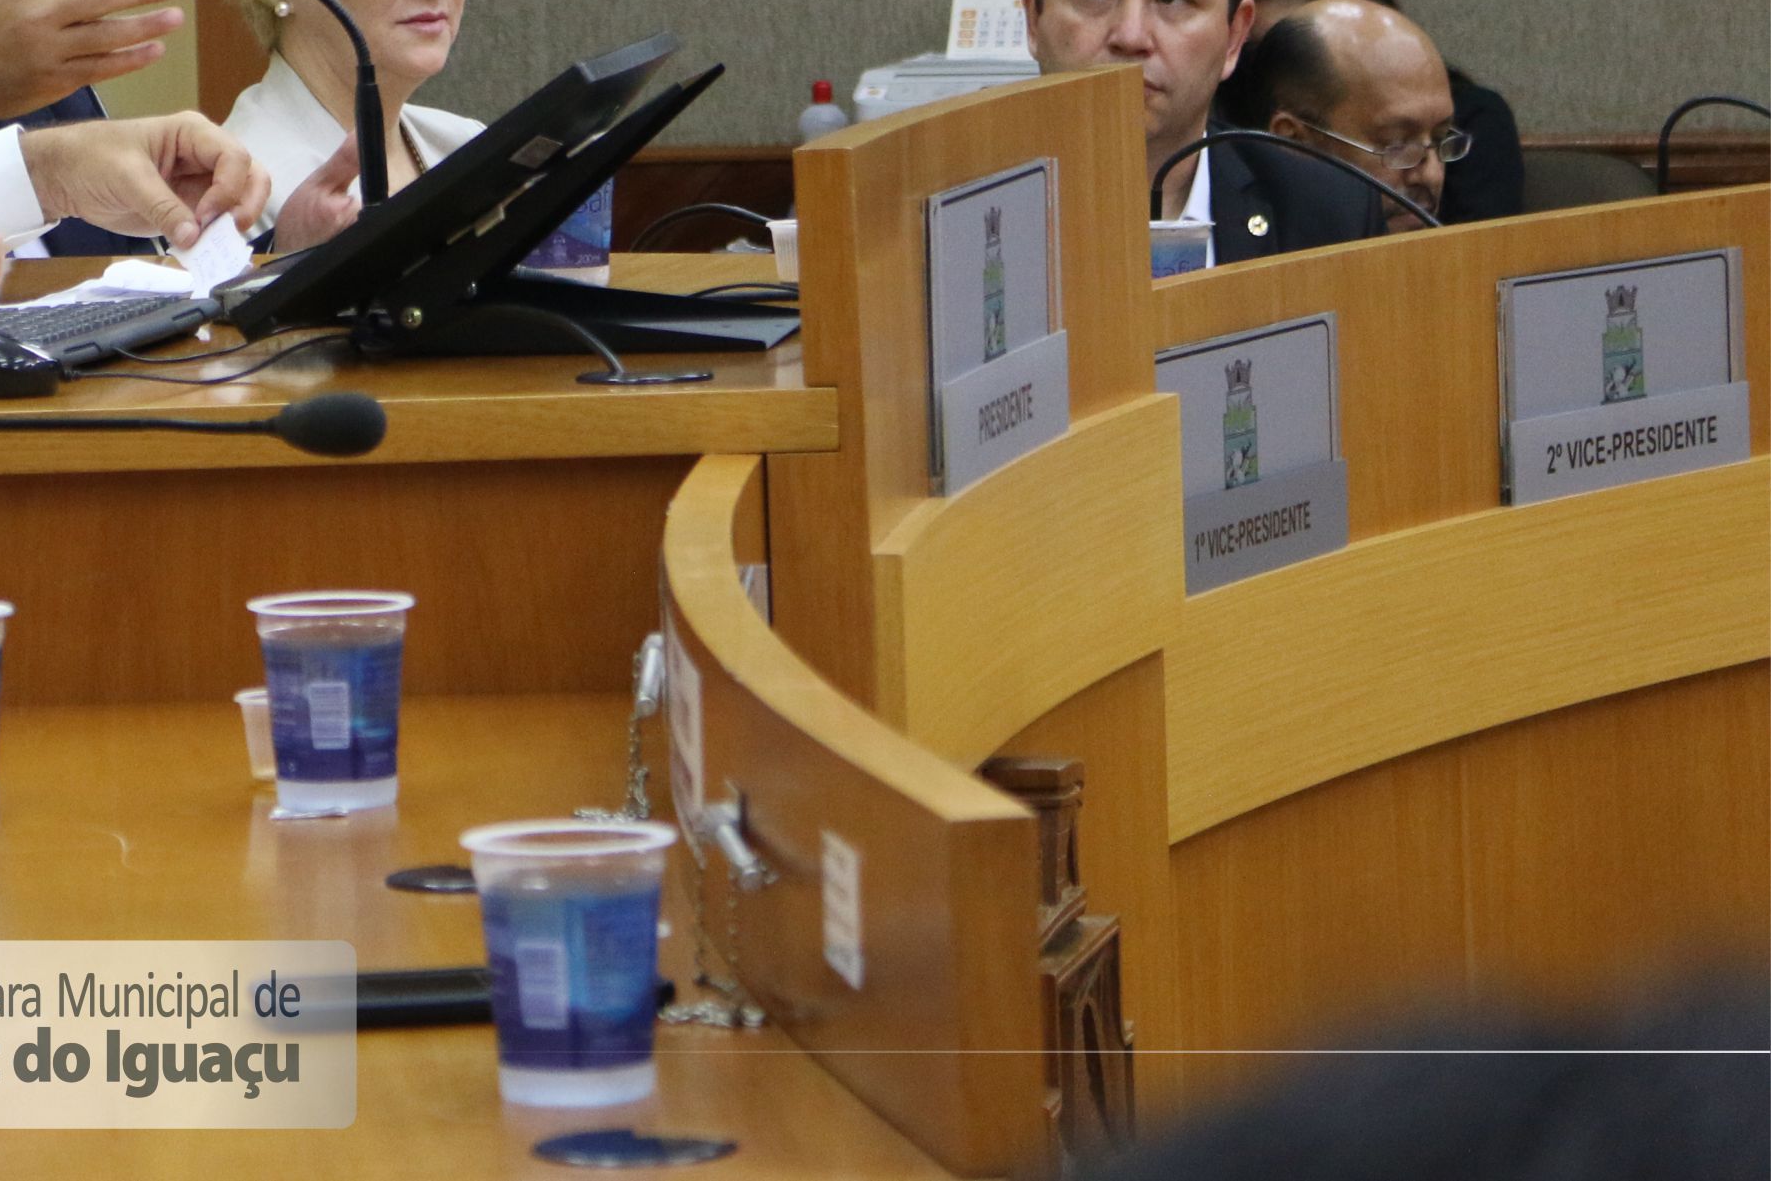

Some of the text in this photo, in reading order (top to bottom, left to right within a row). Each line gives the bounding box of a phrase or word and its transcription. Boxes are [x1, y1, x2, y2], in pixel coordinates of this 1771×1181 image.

[978, 382, 1033, 445] PRESIDENTE
[1546, 415, 1718, 475] 2º VICE-PRESIDENTE
[1194, 500, 1312, 565] 1º VICE-PRESIDENTE
